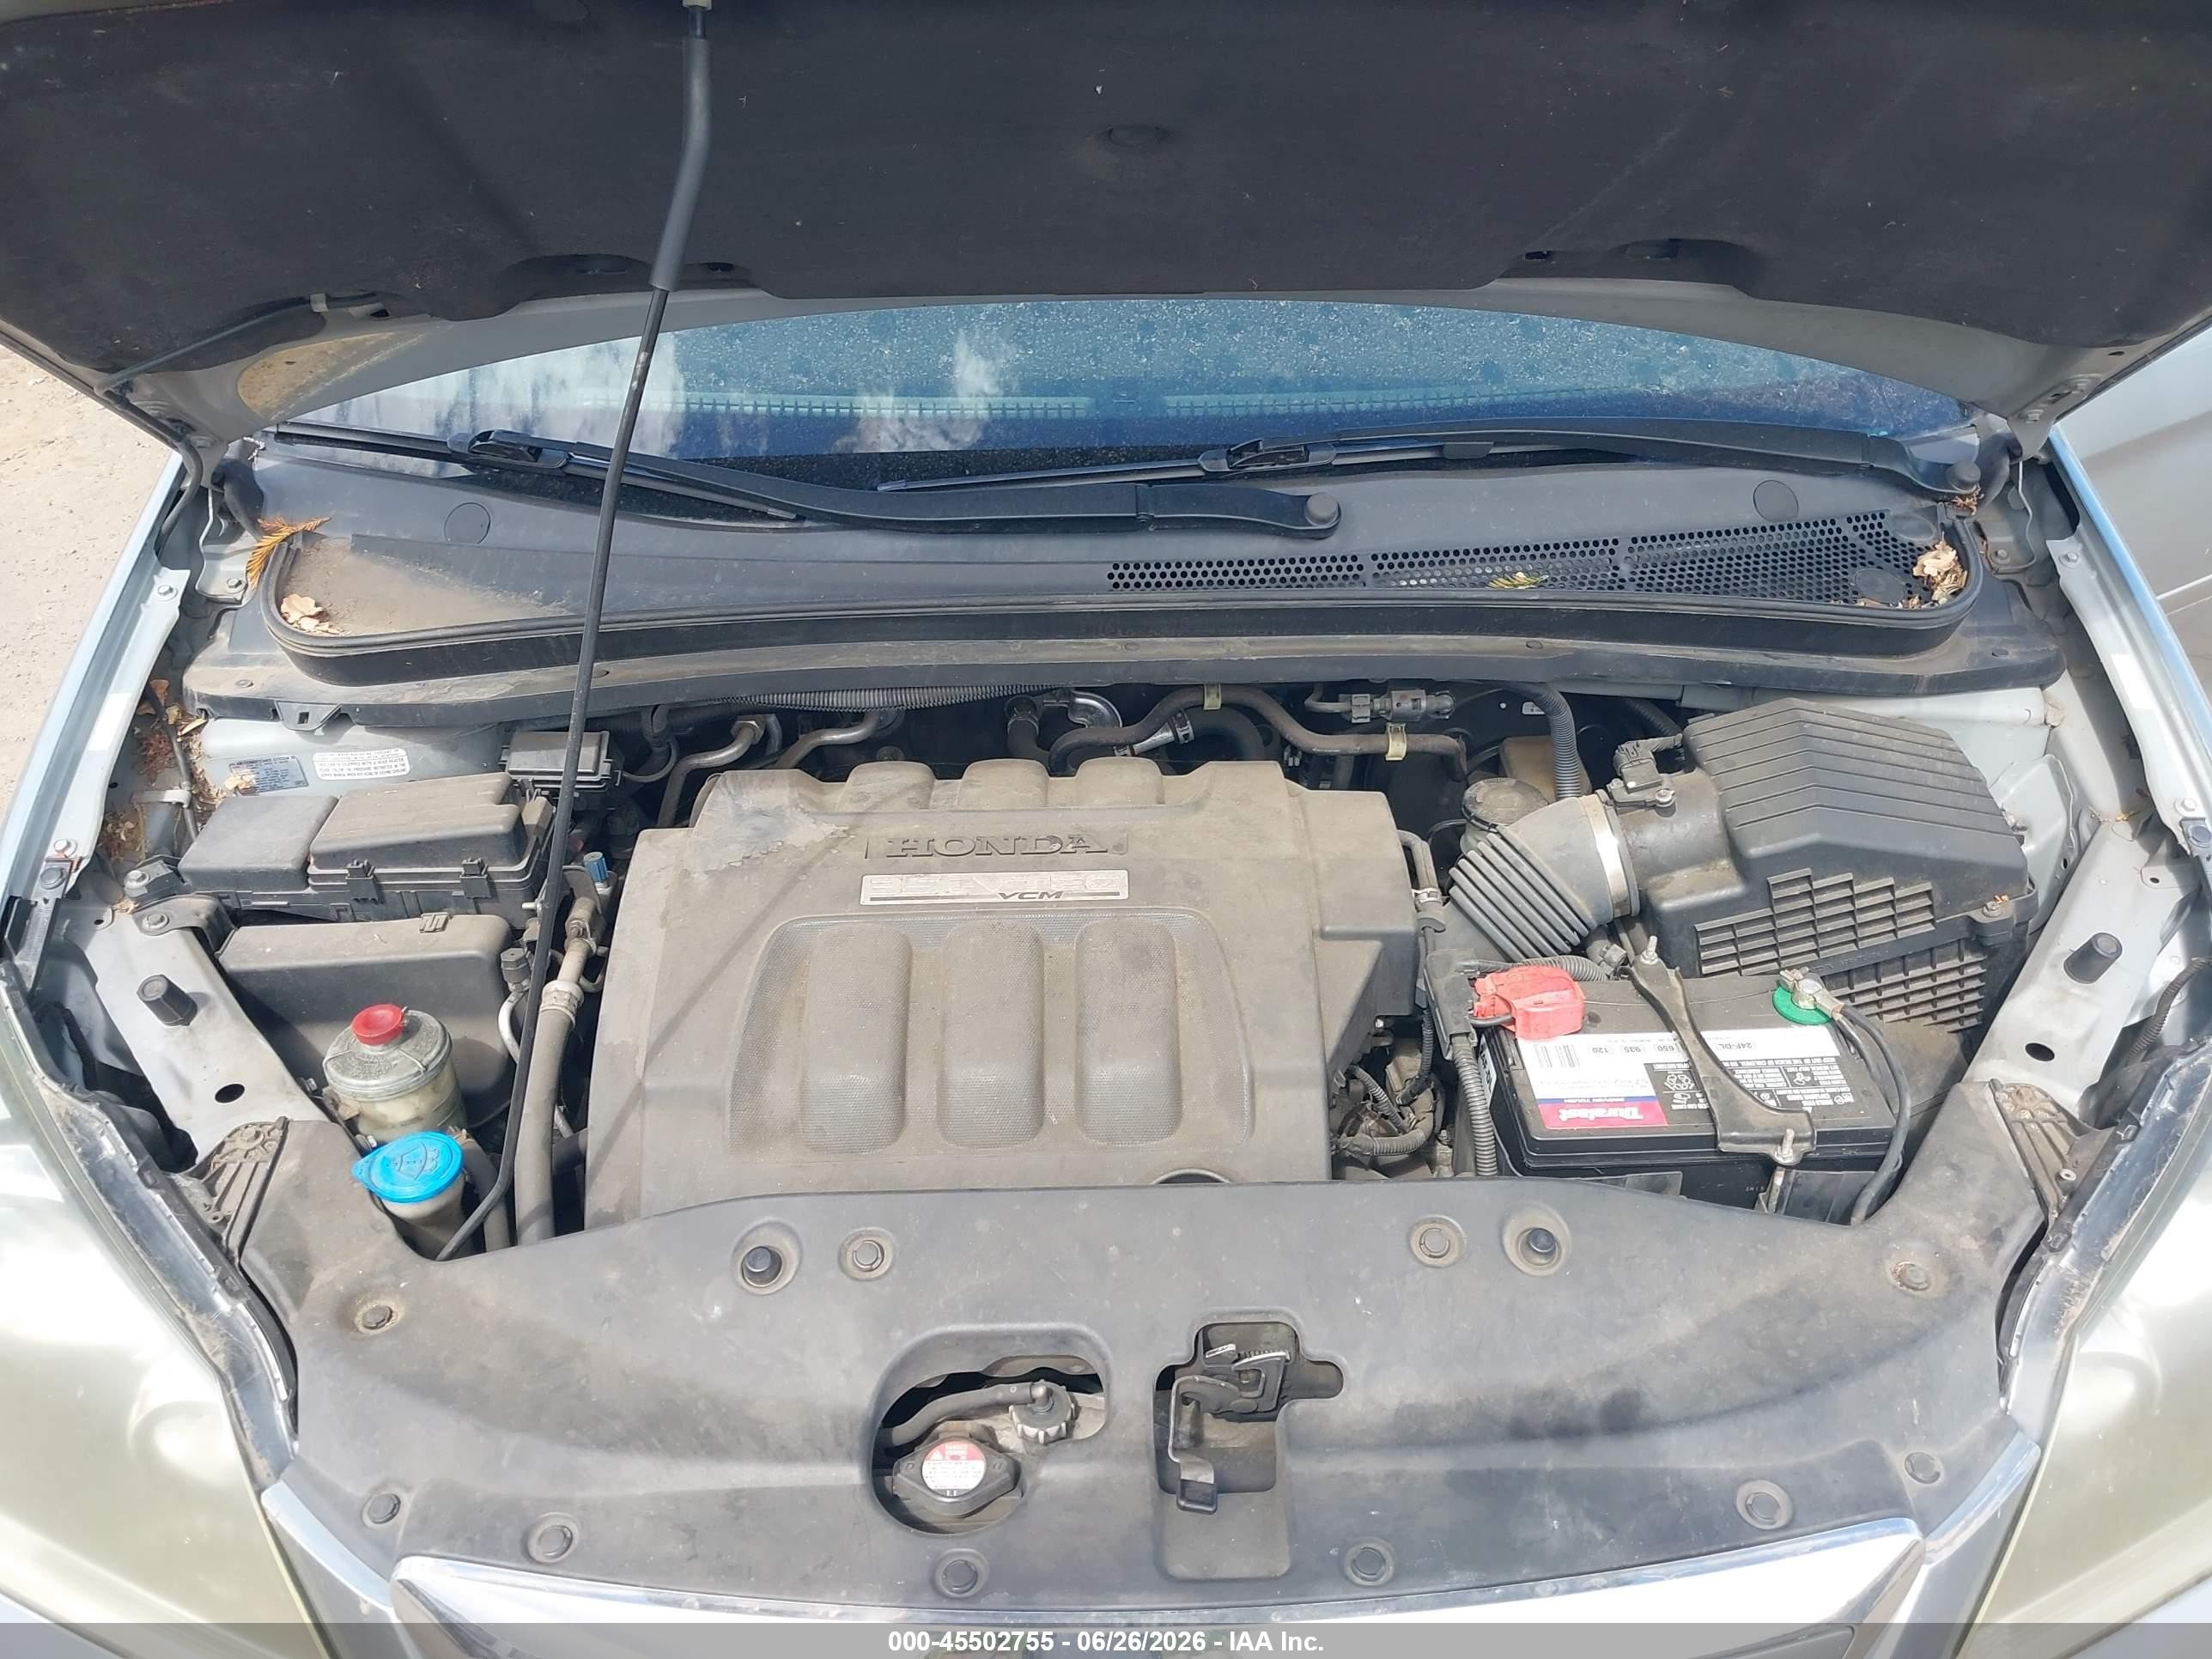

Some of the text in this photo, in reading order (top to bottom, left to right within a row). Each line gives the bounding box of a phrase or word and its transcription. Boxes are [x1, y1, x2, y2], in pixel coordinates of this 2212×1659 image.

[886, 834, 1108, 858] HONDA
[998, 890, 1065, 901] VCM
[1559, 1107, 1644, 1121] Duralast
